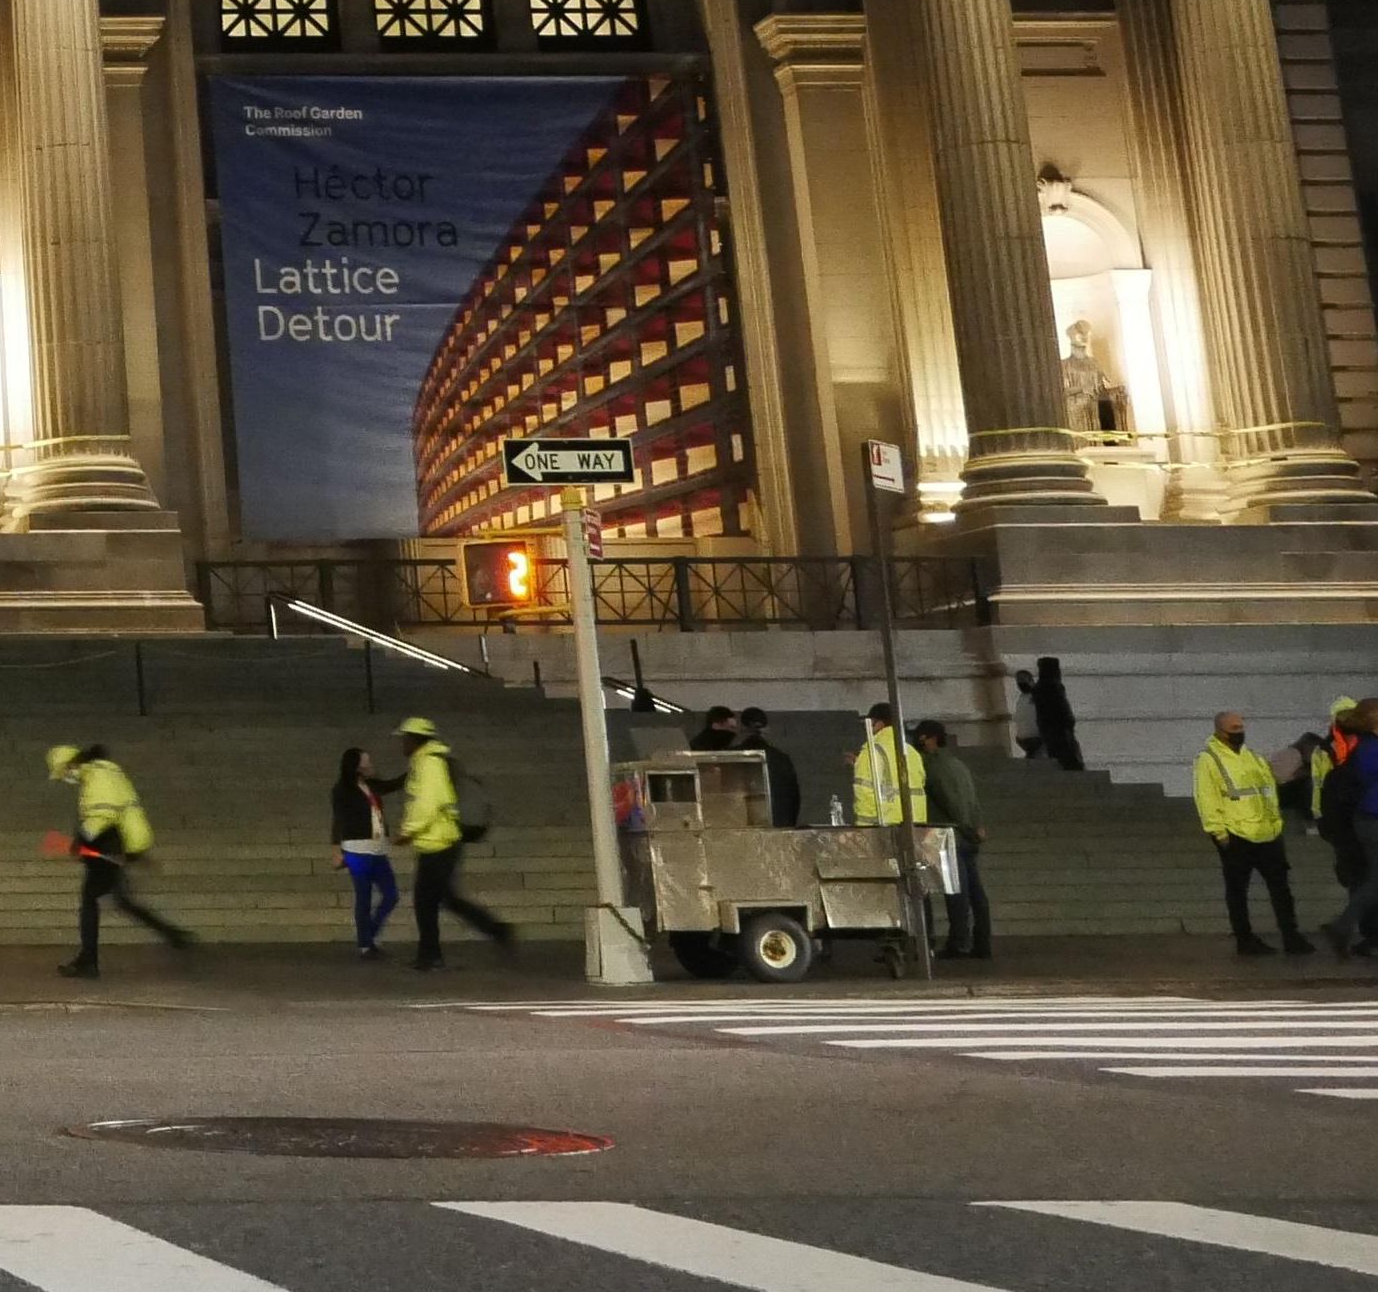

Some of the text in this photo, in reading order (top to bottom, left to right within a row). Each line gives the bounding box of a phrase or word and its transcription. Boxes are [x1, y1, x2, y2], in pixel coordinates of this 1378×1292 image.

[243, 106, 363, 120] The Roof Garden
[245, 124, 332, 137] Commission
[294, 165, 434, 202] Héctor
[298, 212, 459, 247] Zamora
[254, 257, 400, 294] Lattice
[258, 306, 401, 342] Detour
[524, 452, 615, 471] ONE WAY
